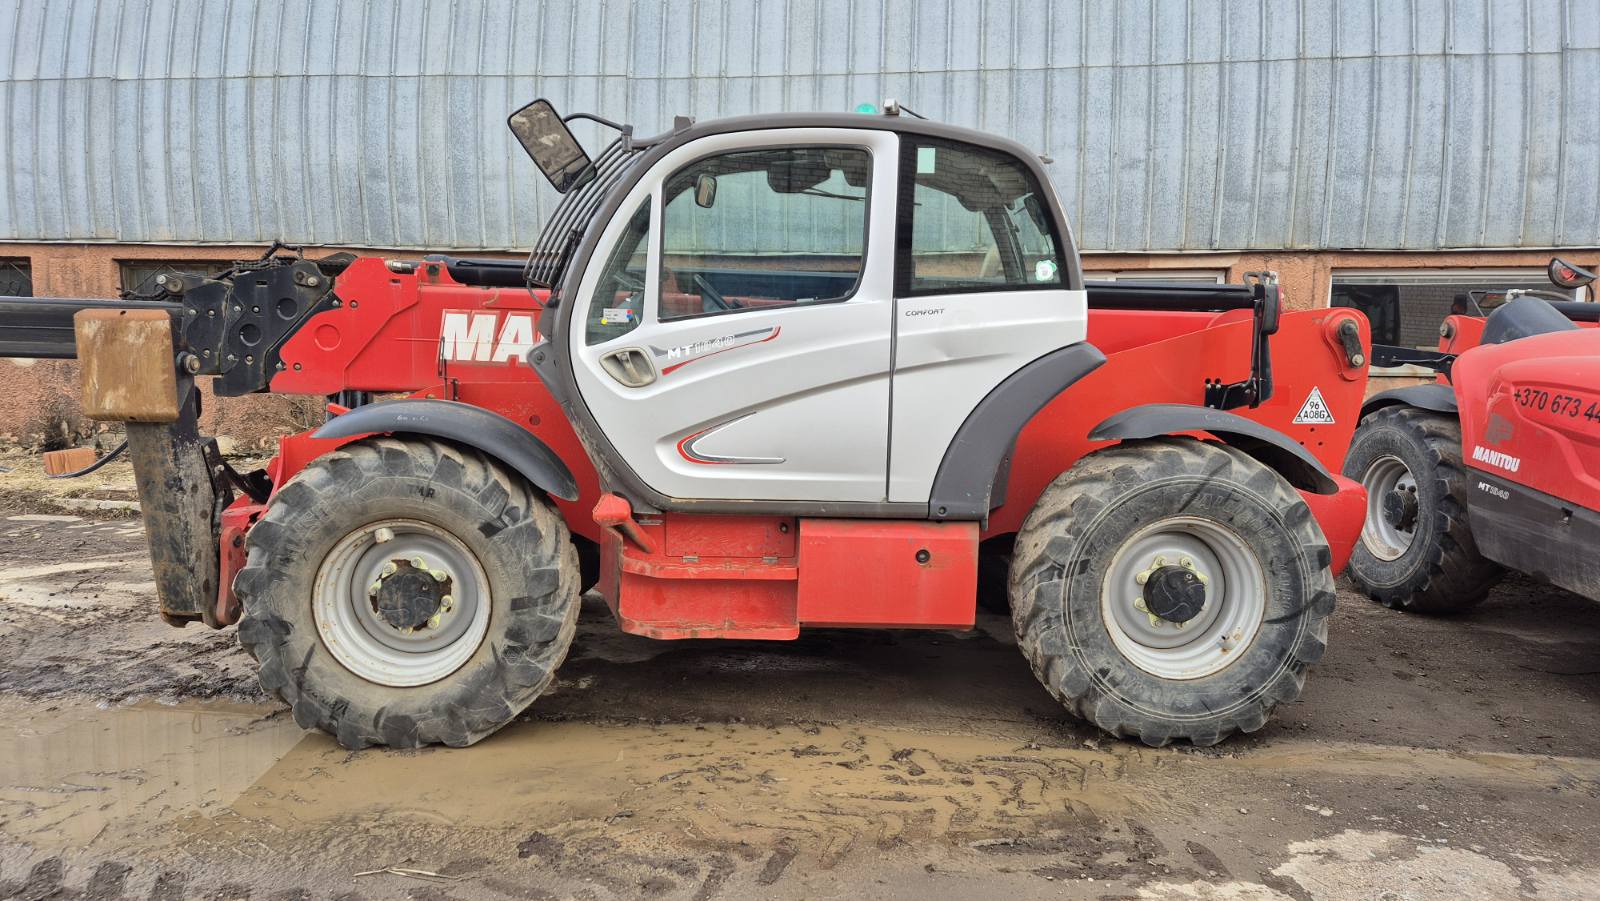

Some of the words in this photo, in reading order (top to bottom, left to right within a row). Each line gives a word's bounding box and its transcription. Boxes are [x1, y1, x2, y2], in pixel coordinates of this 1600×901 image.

[905, 308, 945, 317] COMFORT
[438, 309, 546, 366] MA
[1309, 401, 1320, 410] 96
[1514, 387, 1549, 411] +370
[1551, 394, 1582, 418] 673
[1472, 445, 1520, 473] MANITOU
